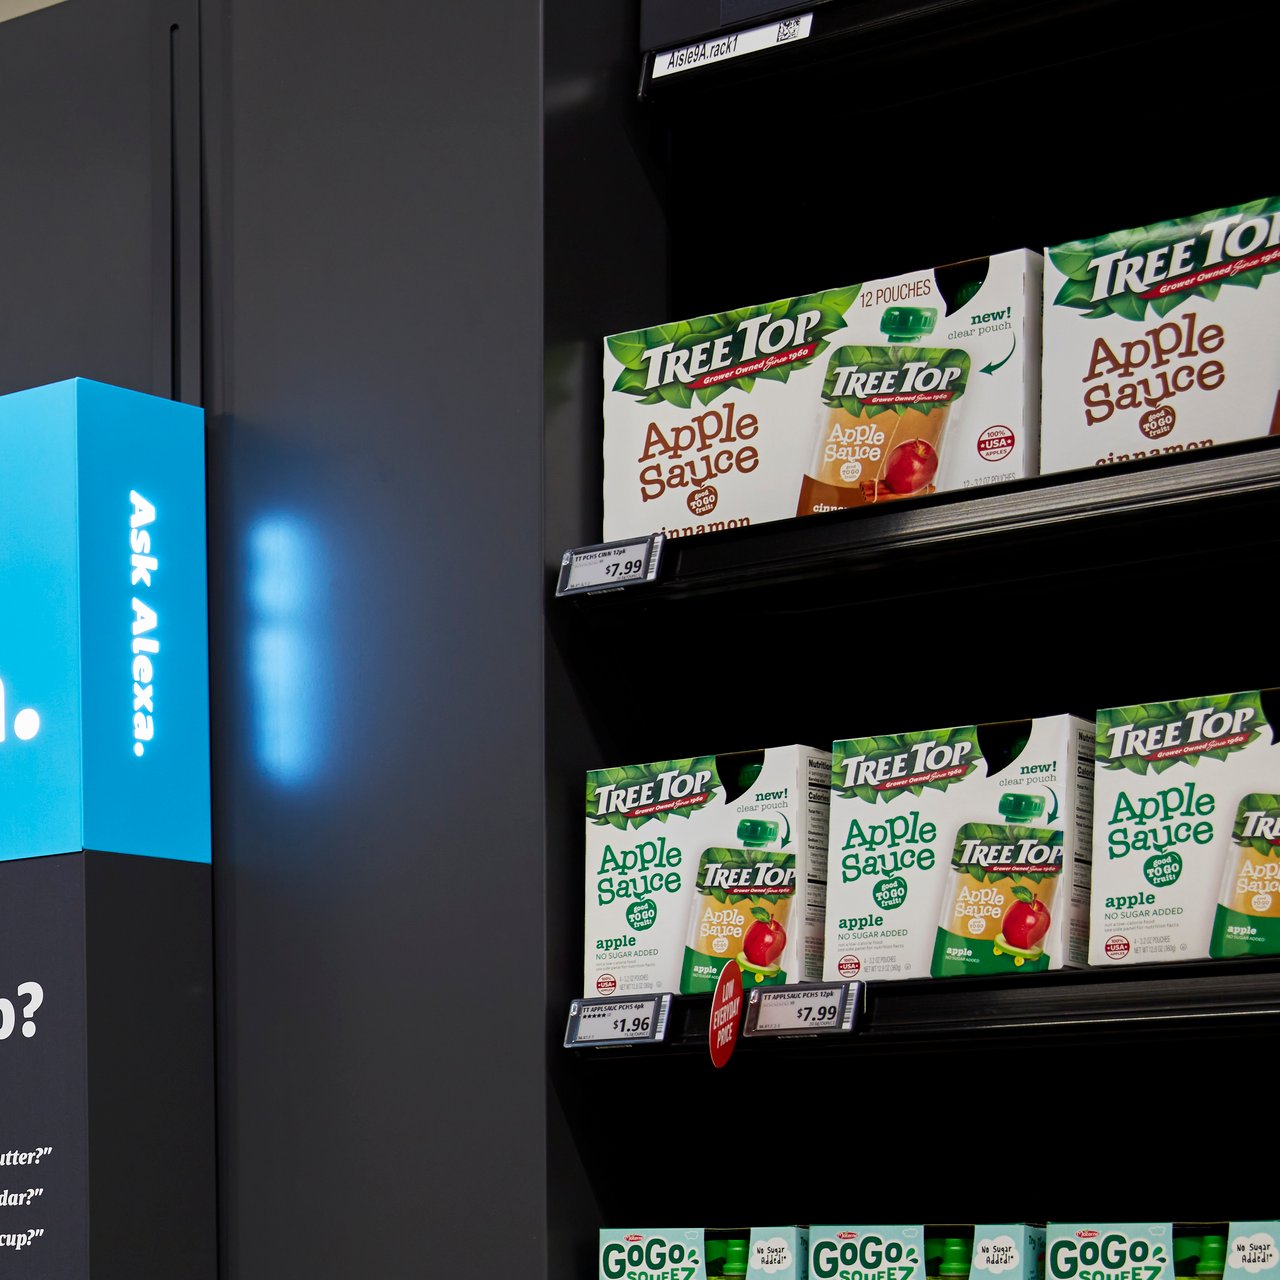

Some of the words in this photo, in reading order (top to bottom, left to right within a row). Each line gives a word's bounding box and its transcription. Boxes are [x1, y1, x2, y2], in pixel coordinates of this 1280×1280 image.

[667, 34, 738, 69] Aisle9A.rack1
[1087, 239, 1195, 302] TREE
[860, 292, 873, 308] 12
[876, 278, 931, 305] POUCHES
[948, 327, 976, 340] clear
[978, 321, 1012, 336] pouch
[970, 306, 1012, 325] new!
[640, 335, 734, 390] TREE
[736, 310, 822, 358] TOP
[1082, 312, 1225, 382] Apple
[703, 370, 734, 385] Grower
[735, 360, 765, 375] Owned
[763, 355, 788, 371] Since
[789, 348, 808, 361] 1960
[830, 366, 899, 399] TREE
[899, 362, 962, 392] TOP
[1083, 360, 1225, 427] Sauce
[638, 402, 759, 463] Apple
[827, 424, 885, 445] Apple
[825, 444, 881, 463] Sauce
[639, 446, 759, 502] Sauce
[130, 489, 158, 587] Ask
[605, 559, 642, 578] $7.99
[132, 597, 159, 757] Alexa.
[1106, 723, 1182, 760] TREE
[1185, 707, 1255, 741] TOP
[840, 754, 908, 788] TREE
[909, 740, 972, 773] TOP
[594, 782, 654, 815] TREE
[654, 769, 712, 800] TOP
[755, 788, 788, 802] new!
[1107, 782, 1215, 825] Apple
[841, 811, 936, 851] Apple
[1107, 821, 1214, 860] Sauce
[597, 837, 682, 876] Apple
[841, 848, 936, 883] Sauce
[597, 871, 682, 906] Sauce
[1105, 892, 1155, 908] apple
[839, 915, 883, 931] apple
[1104, 912, 1119, 920] NO
[1120, 910, 1150, 918] SUGAR
[1152, 907, 1183, 916] ADDED
[596, 935, 636, 951] apple
[591, 1004, 618, 1012] APPLSAUC
[722, 983, 734, 1003] LOW
[613, 1017, 650, 1032] $1.96
[714, 1000, 741, 1027] EVERYDAY
[797, 1006, 837, 1022] $7.99
[716, 1023, 733, 1048] PRICE
[602, 1238, 685, 1279] GoGo
[813, 1236, 903, 1278] GoGo
[1049, 1234, 1149, 1279] GoGo
